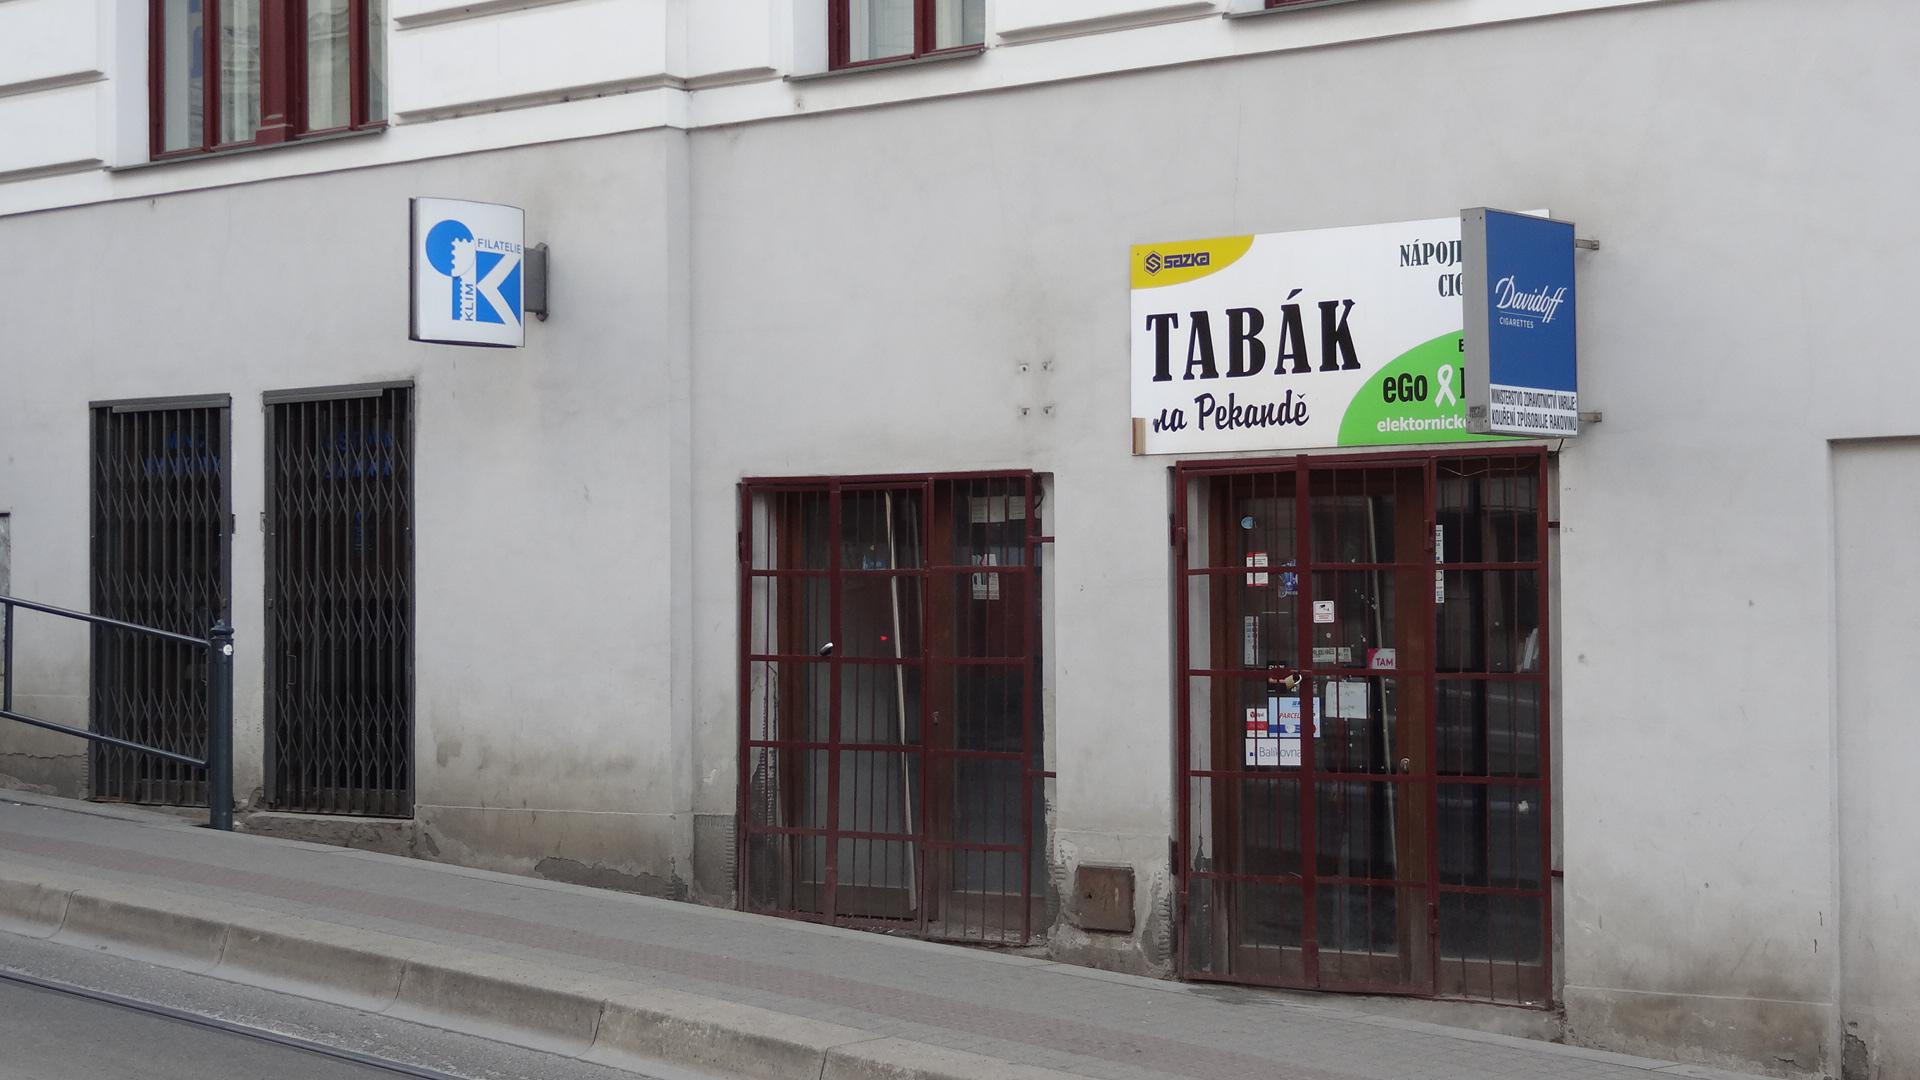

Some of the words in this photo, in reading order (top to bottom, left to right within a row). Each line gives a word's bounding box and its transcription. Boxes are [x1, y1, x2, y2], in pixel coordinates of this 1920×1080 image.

[477, 238, 522, 254] FILATELIE
[465, 283, 474, 321] KLIM
[1495, 275, 1567, 323] Davidoff
[1146, 288, 1360, 382] TABÁK
[1499, 316, 1534, 329] CIGARETTES
[1383, 373, 1428, 403] eGo
[1194, 389, 1309, 431] Pekandě
[1491, 406, 1516, 426] KOUŘENÍ
[1517, 408, 1549, 429] ZPŮSOBUJE
[1549, 414, 1577, 431] RAKOVINU
[1376, 657, 1393, 666] TAM
